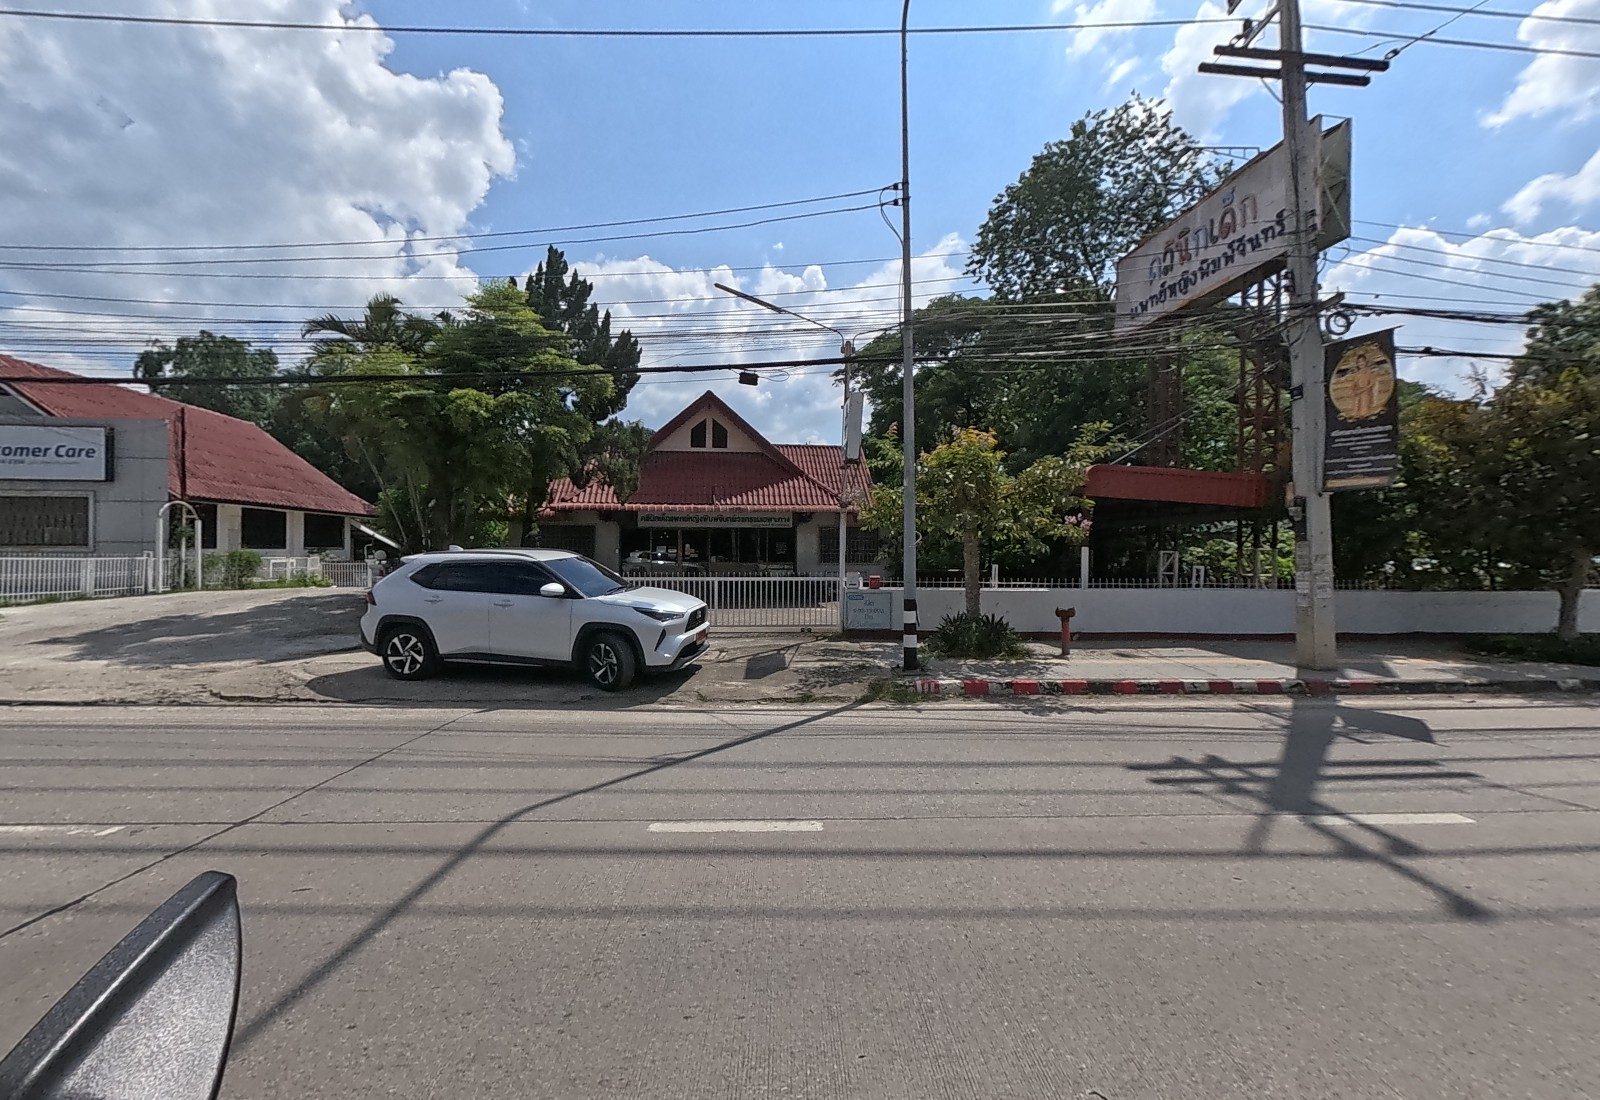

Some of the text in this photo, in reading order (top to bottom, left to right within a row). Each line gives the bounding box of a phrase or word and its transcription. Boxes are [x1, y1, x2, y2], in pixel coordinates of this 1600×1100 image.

[1148, 186, 1258, 286] คลินิกเด็ก
[0, 445, 96, 458] omer Care
